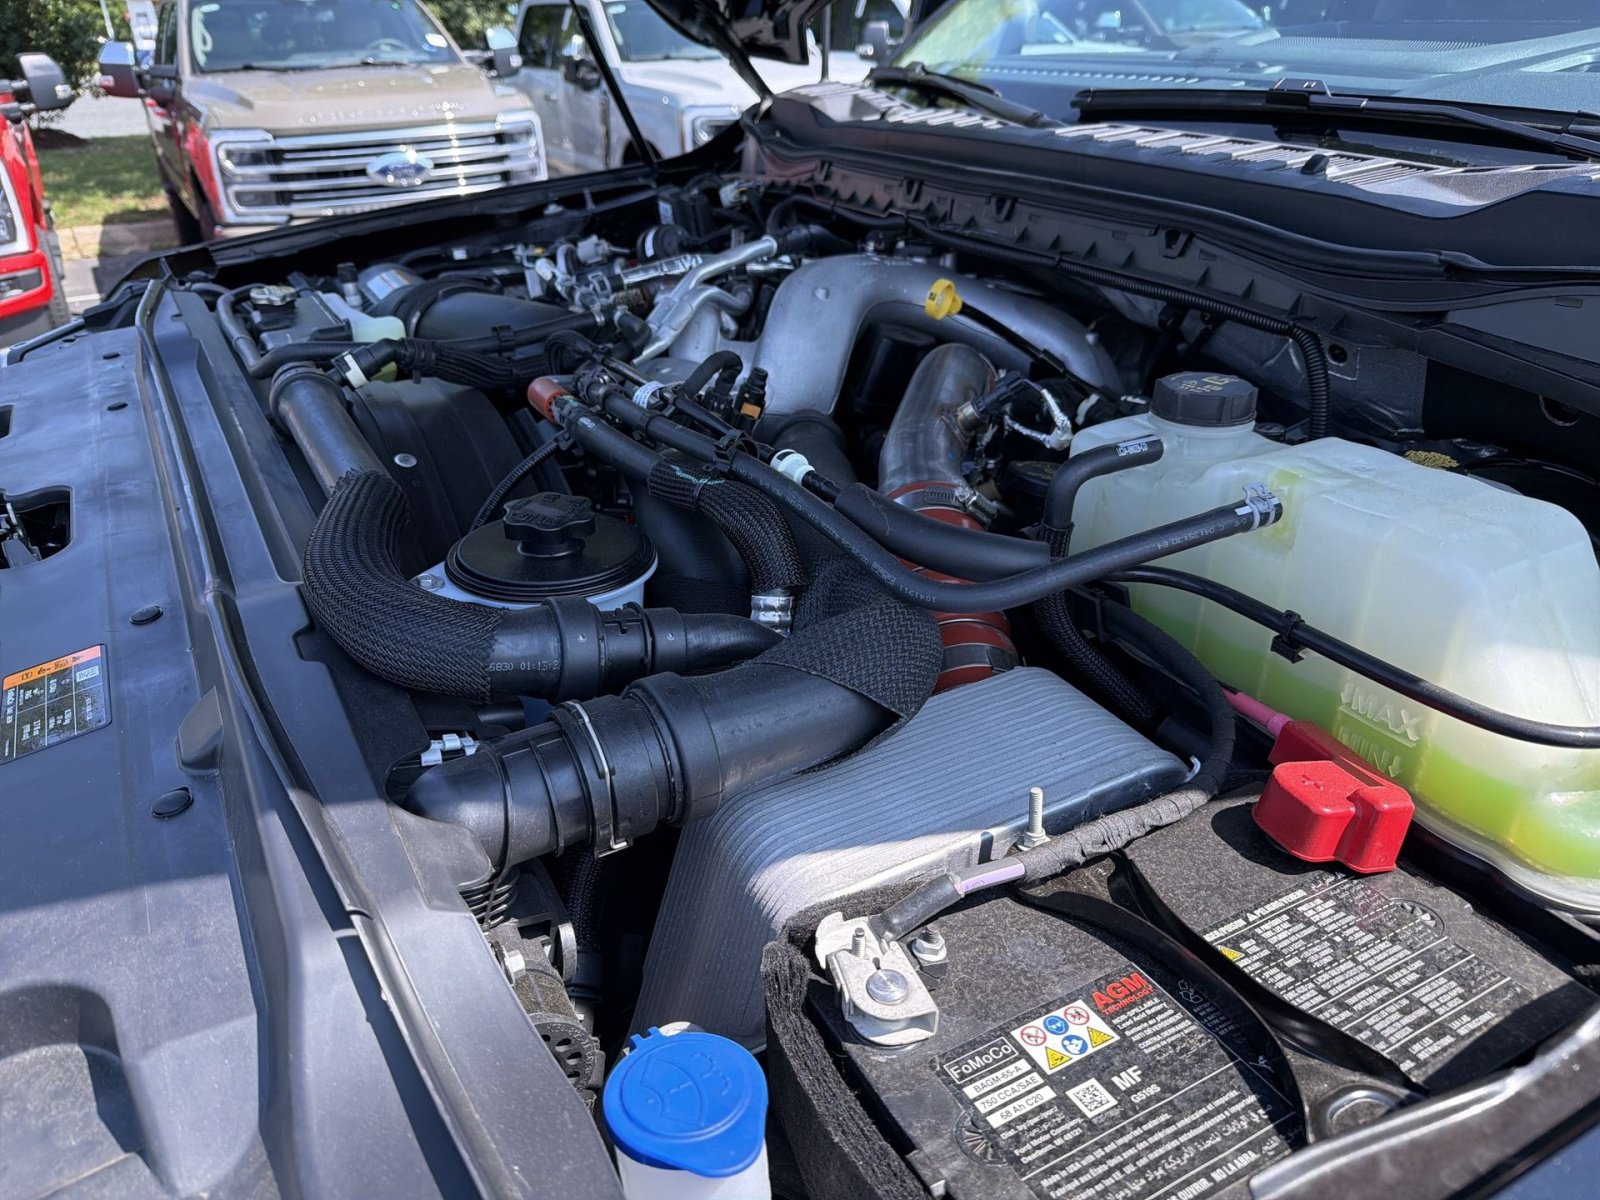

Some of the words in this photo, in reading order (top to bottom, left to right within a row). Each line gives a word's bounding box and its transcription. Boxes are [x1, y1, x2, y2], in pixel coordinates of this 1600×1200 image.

[1351, 686, 1424, 742] MAX
[1091, 970, 1149, 1007] AGM
[1101, 985, 1154, 1016] TECHNOLOGY
[949, 1040, 1012, 1079] FoMoCo
[972, 1063, 1023, 1093] BAGM-65-A
[980, 1096, 999, 1109] 750
[997, 1075, 1039, 1100] CCA/SAE
[1110, 1066, 1146, 1090] MF
[999, 1109, 1013, 1120] 68
[1011, 1102, 1026, 1113] Ah
[1024, 1092, 1044, 1106] C20
[1013, 1142, 1033, 1155] Ford
[1030, 1132, 1052, 1146] Motor
[1062, 1126, 1084, 1140] 48121
